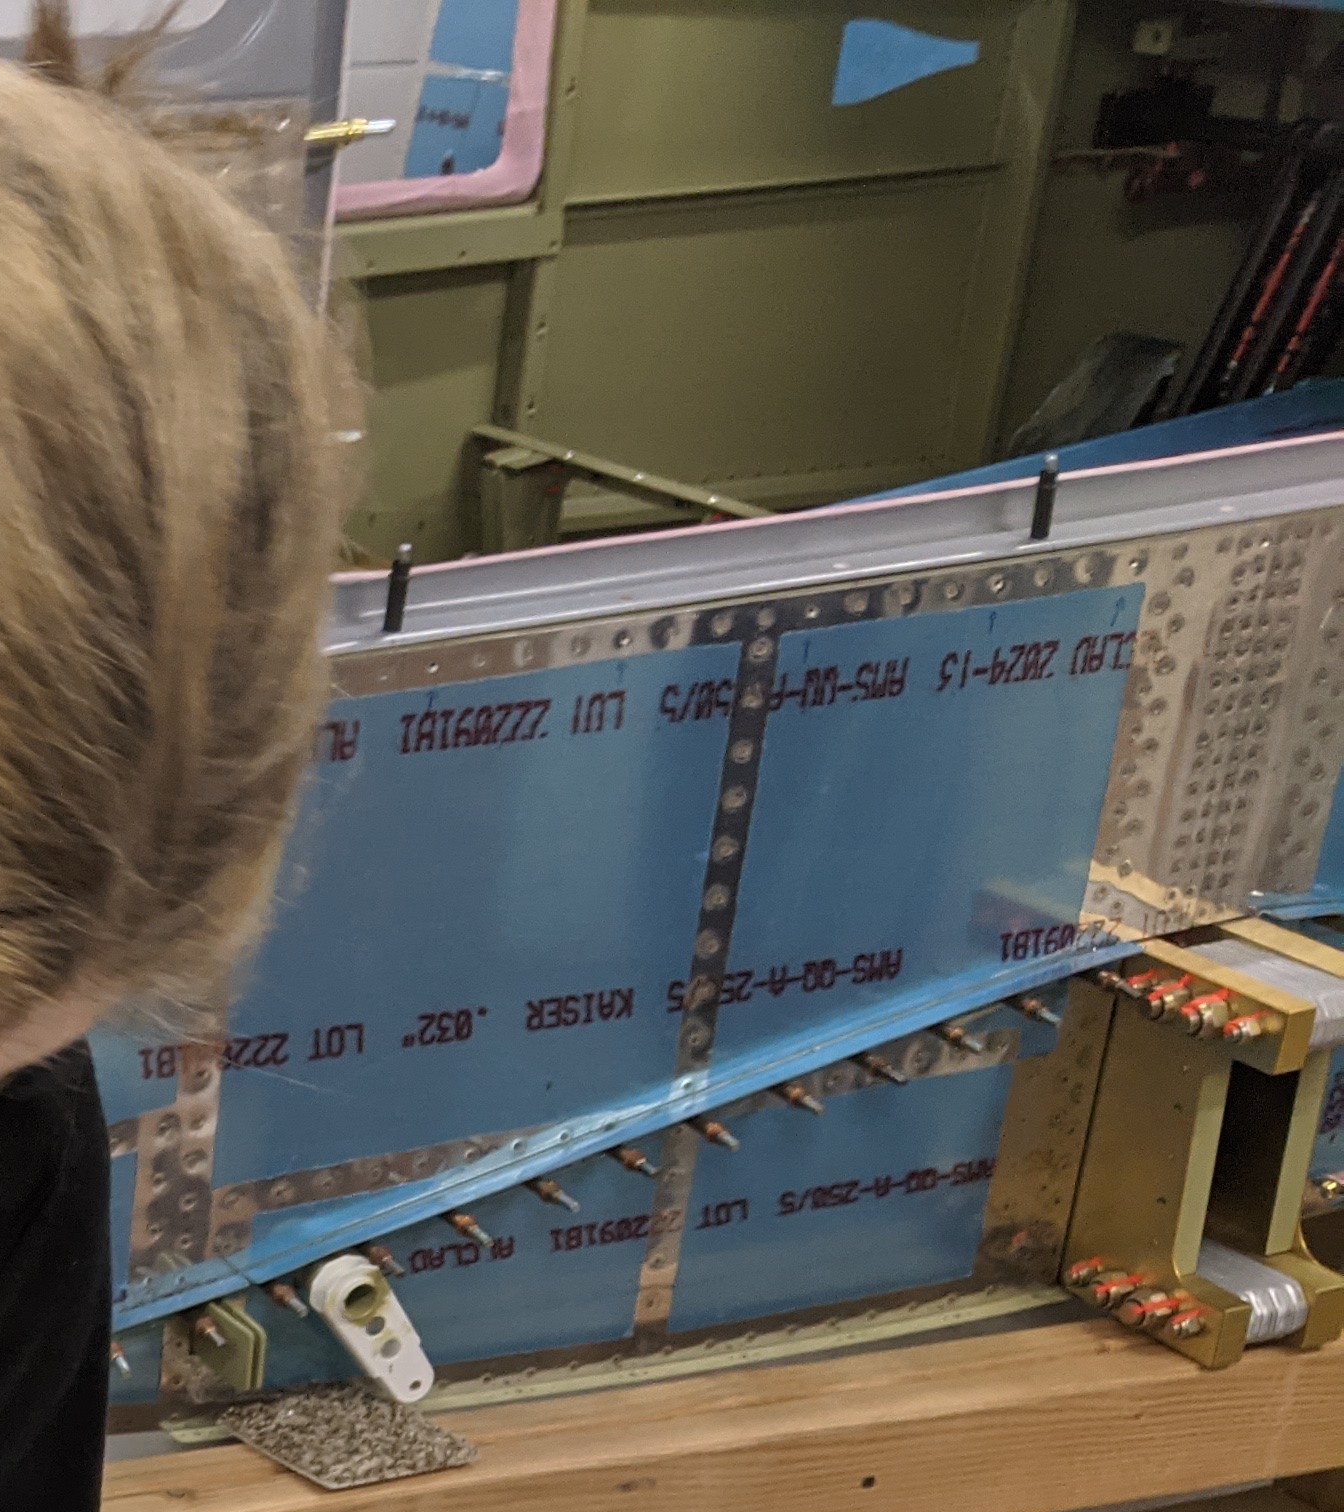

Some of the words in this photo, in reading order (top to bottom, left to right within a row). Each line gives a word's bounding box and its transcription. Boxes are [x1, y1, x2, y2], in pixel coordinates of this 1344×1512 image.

[665, 946, 904, 1014] AMS-QQ-A-255
[525, 987, 636, 1032] KAISER
[307, 1022, 365, 1063] LOT
[695, 1198, 750, 1231] LOT
